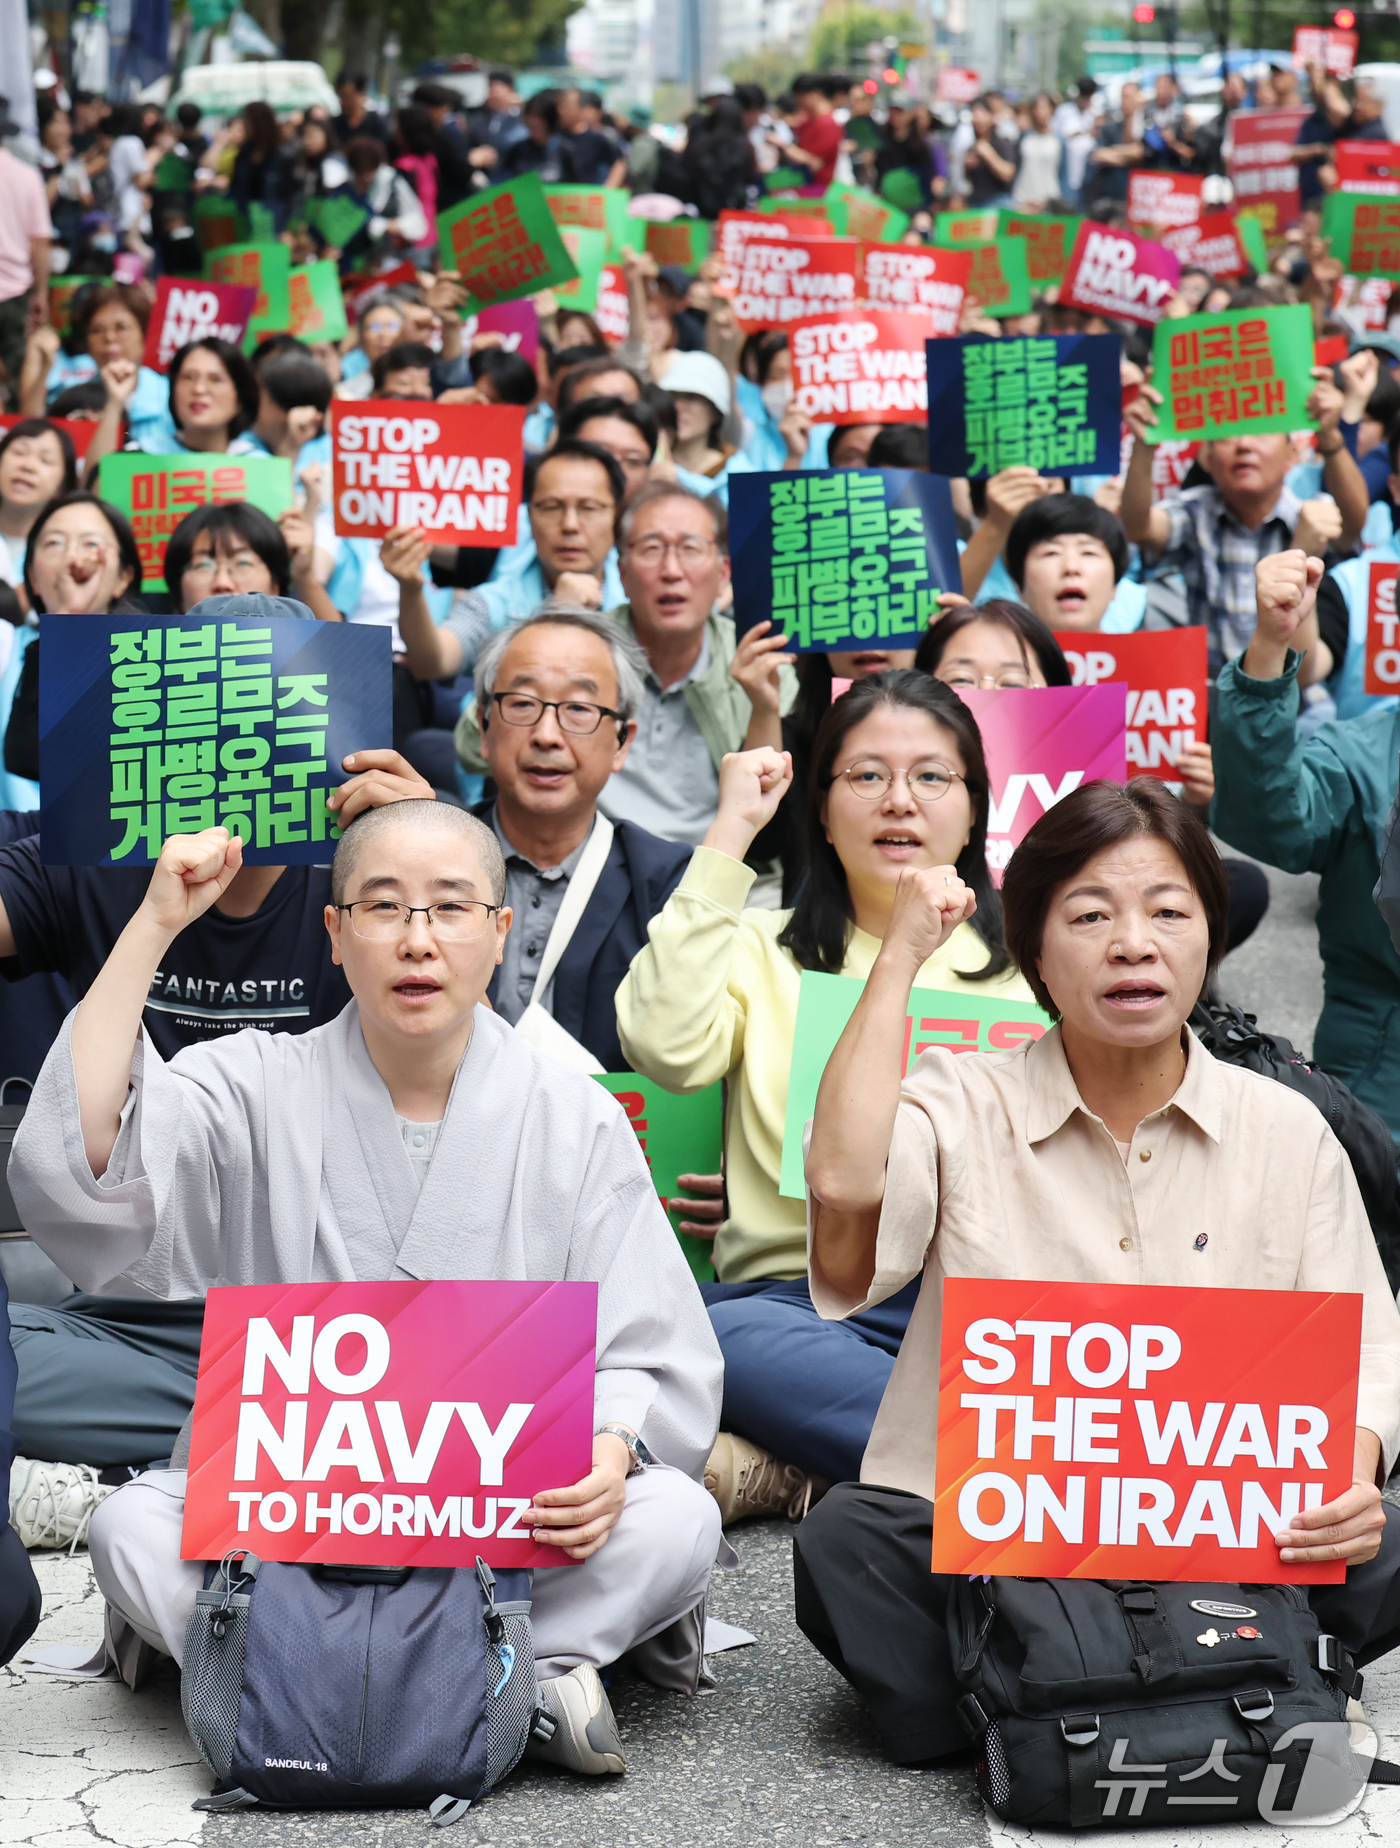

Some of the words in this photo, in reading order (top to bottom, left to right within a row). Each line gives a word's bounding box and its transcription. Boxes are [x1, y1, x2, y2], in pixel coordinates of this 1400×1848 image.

[746, 246, 811, 271] STOP
[866, 251, 936, 278] STOP
[1085, 231, 1137, 272] NO
[167, 287, 220, 325] NO
[794, 321, 878, 355] STOP
[962, 338, 1057, 380] 정부는
[1171, 318, 1271, 368] 미국은
[795, 352, 858, 384] THE
[798, 382, 848, 414] ON
[849, 379, 928, 412] IRAN
[1173, 379, 1286, 432] 멈춰라!
[338, 415, 440, 453] STOP
[338, 452, 411, 489] THE
[414, 454, 511, 493] WAR
[339, 489, 395, 527] ON
[398, 490, 508, 532] IRAN!
[770, 472, 885, 525] 정부는
[771, 548, 929, 608] 파병요구
[110, 623, 273, 689] 정부는
[110, 729, 328, 804] 파병요구
[151, 971, 305, 1003] FANTASTIC
[175, 1017, 202, 1028] Always
[241, 1313, 391, 1396] NO
[961, 1317, 1182, 1389] STOP
[233, 1400, 535, 1486] NAVY
[960, 1393, 1122, 1463] THE
[1133, 1399, 1330, 1470] WAR
[228, 1491, 298, 1533] TO
[304, 1492, 543, 1540] HORMUZ
[957, 1471, 1086, 1545] ON
[265, 1758, 313, 1770] SANDEUL
[315, 1762, 328, 1772] 18
